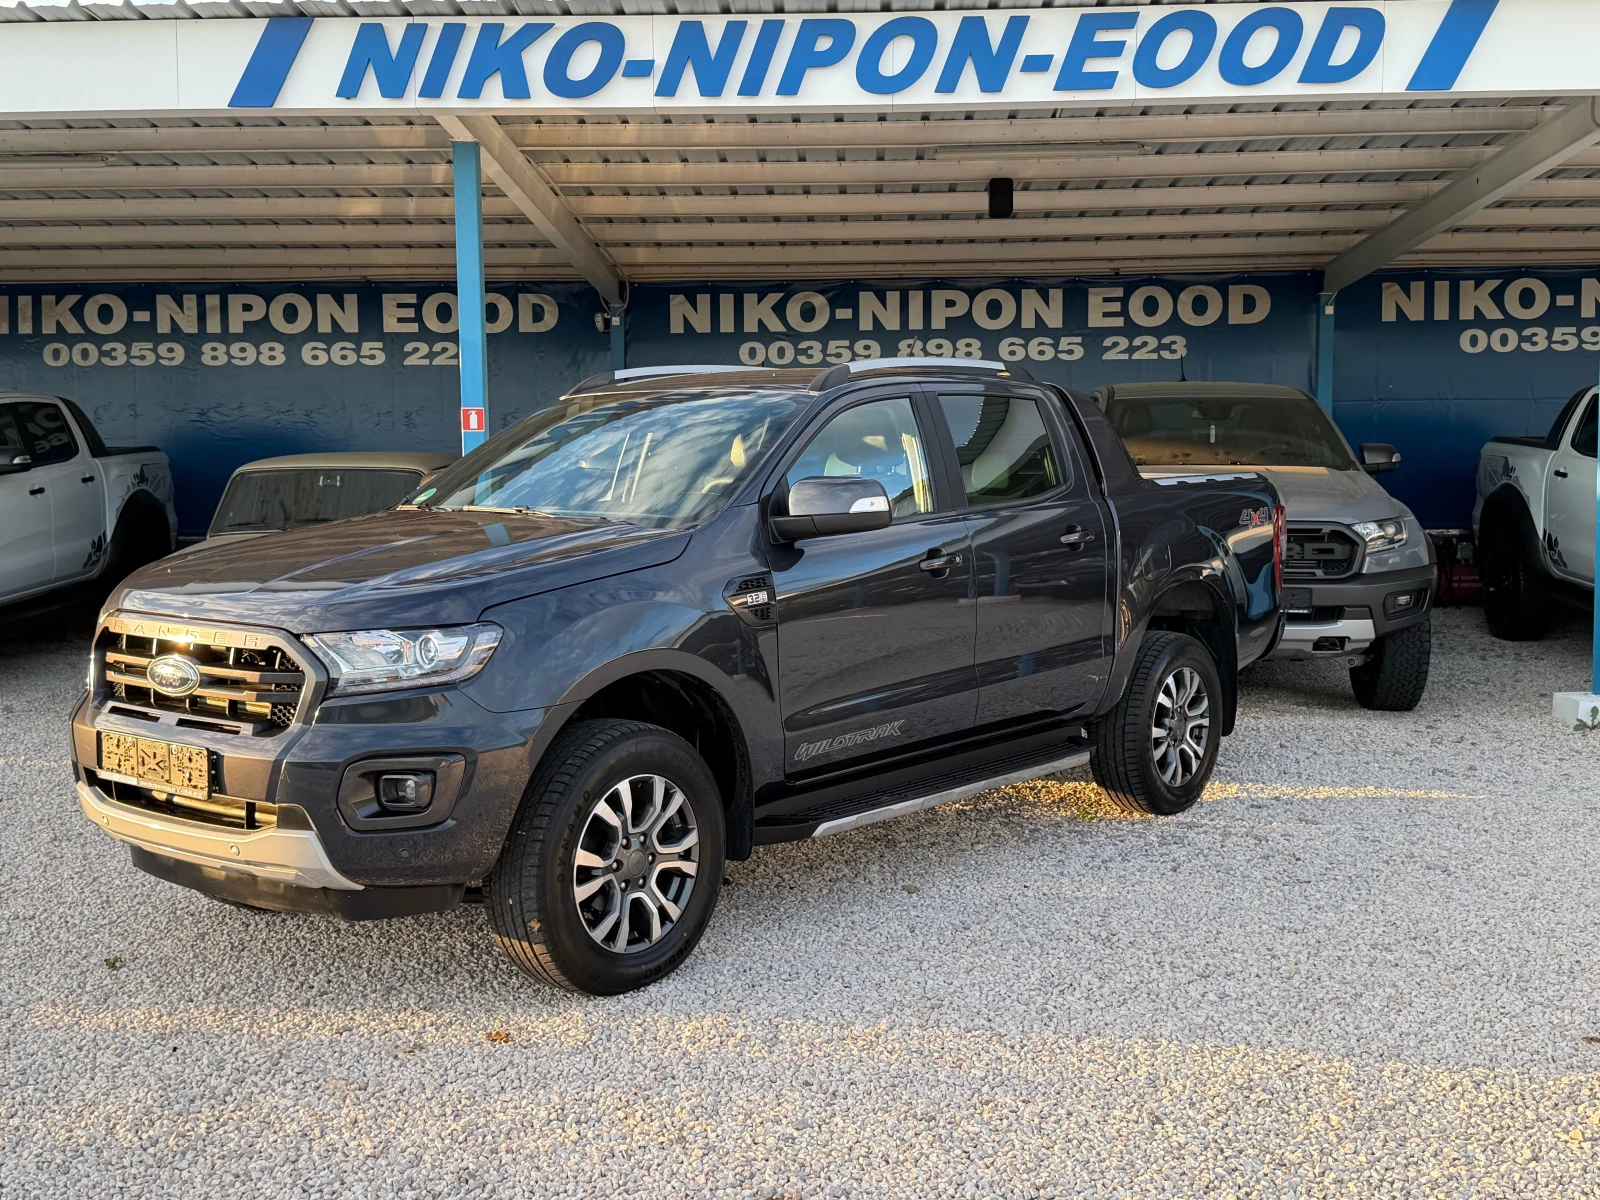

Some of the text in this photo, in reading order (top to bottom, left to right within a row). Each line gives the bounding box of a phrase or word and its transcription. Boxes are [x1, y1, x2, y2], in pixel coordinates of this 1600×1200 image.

[336, 7, 1385, 100] NIKO-NIPON-EOOD
[0, 293, 359, 335] IKO-NIPON
[669, 284, 1271, 334] NIKO-NIPON EOOD
[42, 341, 459, 367] 00359 898 665 22
[738, 335, 1188, 366] 00359 898 665 223
[1459, 326, 1600, 354] 00359
[113, 618, 262, 647] RANGER
[795, 719, 905, 761] WILDTRAK
[556, 789, 592, 884] DYNAMO
